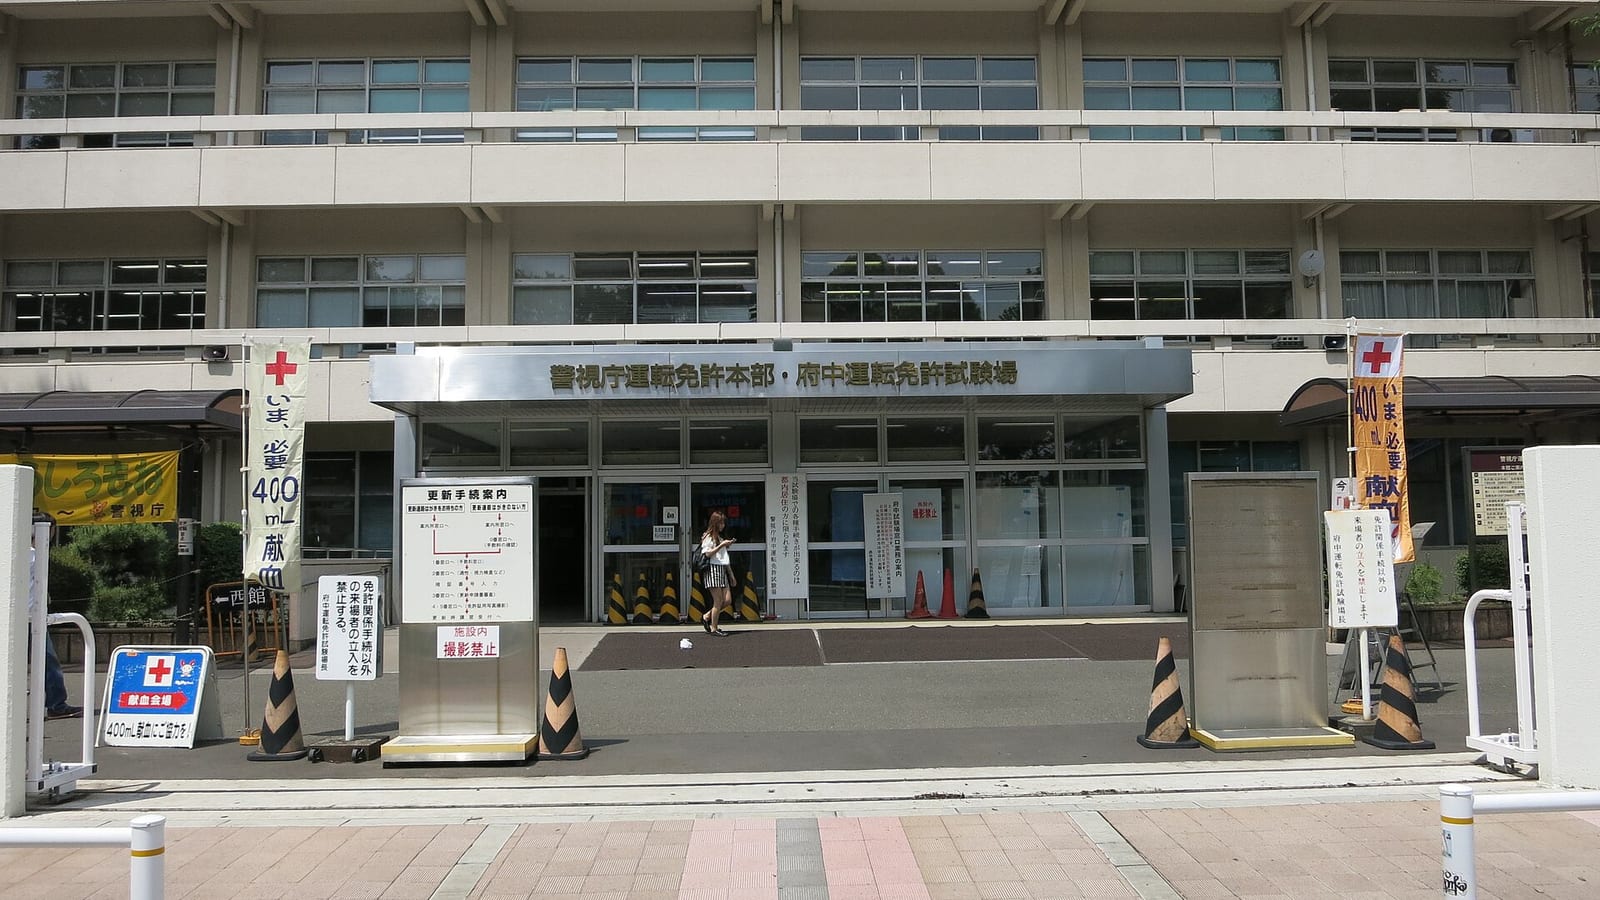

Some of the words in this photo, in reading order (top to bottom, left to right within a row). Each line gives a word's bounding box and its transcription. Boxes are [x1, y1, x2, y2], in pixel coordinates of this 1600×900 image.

[550, 362, 1017, 389] 警視庁運転免許本部・府中運転免許試験場
[1355, 385, 1378, 422] 400
[252, 476, 299, 504] 400
[428, 489, 507, 501] 更新手続案内
[111, 503, 165, 518] 警視庁
[265, 506, 295, 525] mL
[258, 533, 285, 591] 献血
[1374, 516, 1387, 593] 免許関係手続以外の
[229, 586, 266, 607] 西館
[336, 581, 347, 633] 禁止する。
[348, 581, 361, 676] の来場者の立入を
[361, 581, 374, 676] 免許関係手続以外
[454, 626, 488, 637] 施設内
[443, 641, 497, 657] 撮影禁止
[127, 694, 172, 706] 献血会場
